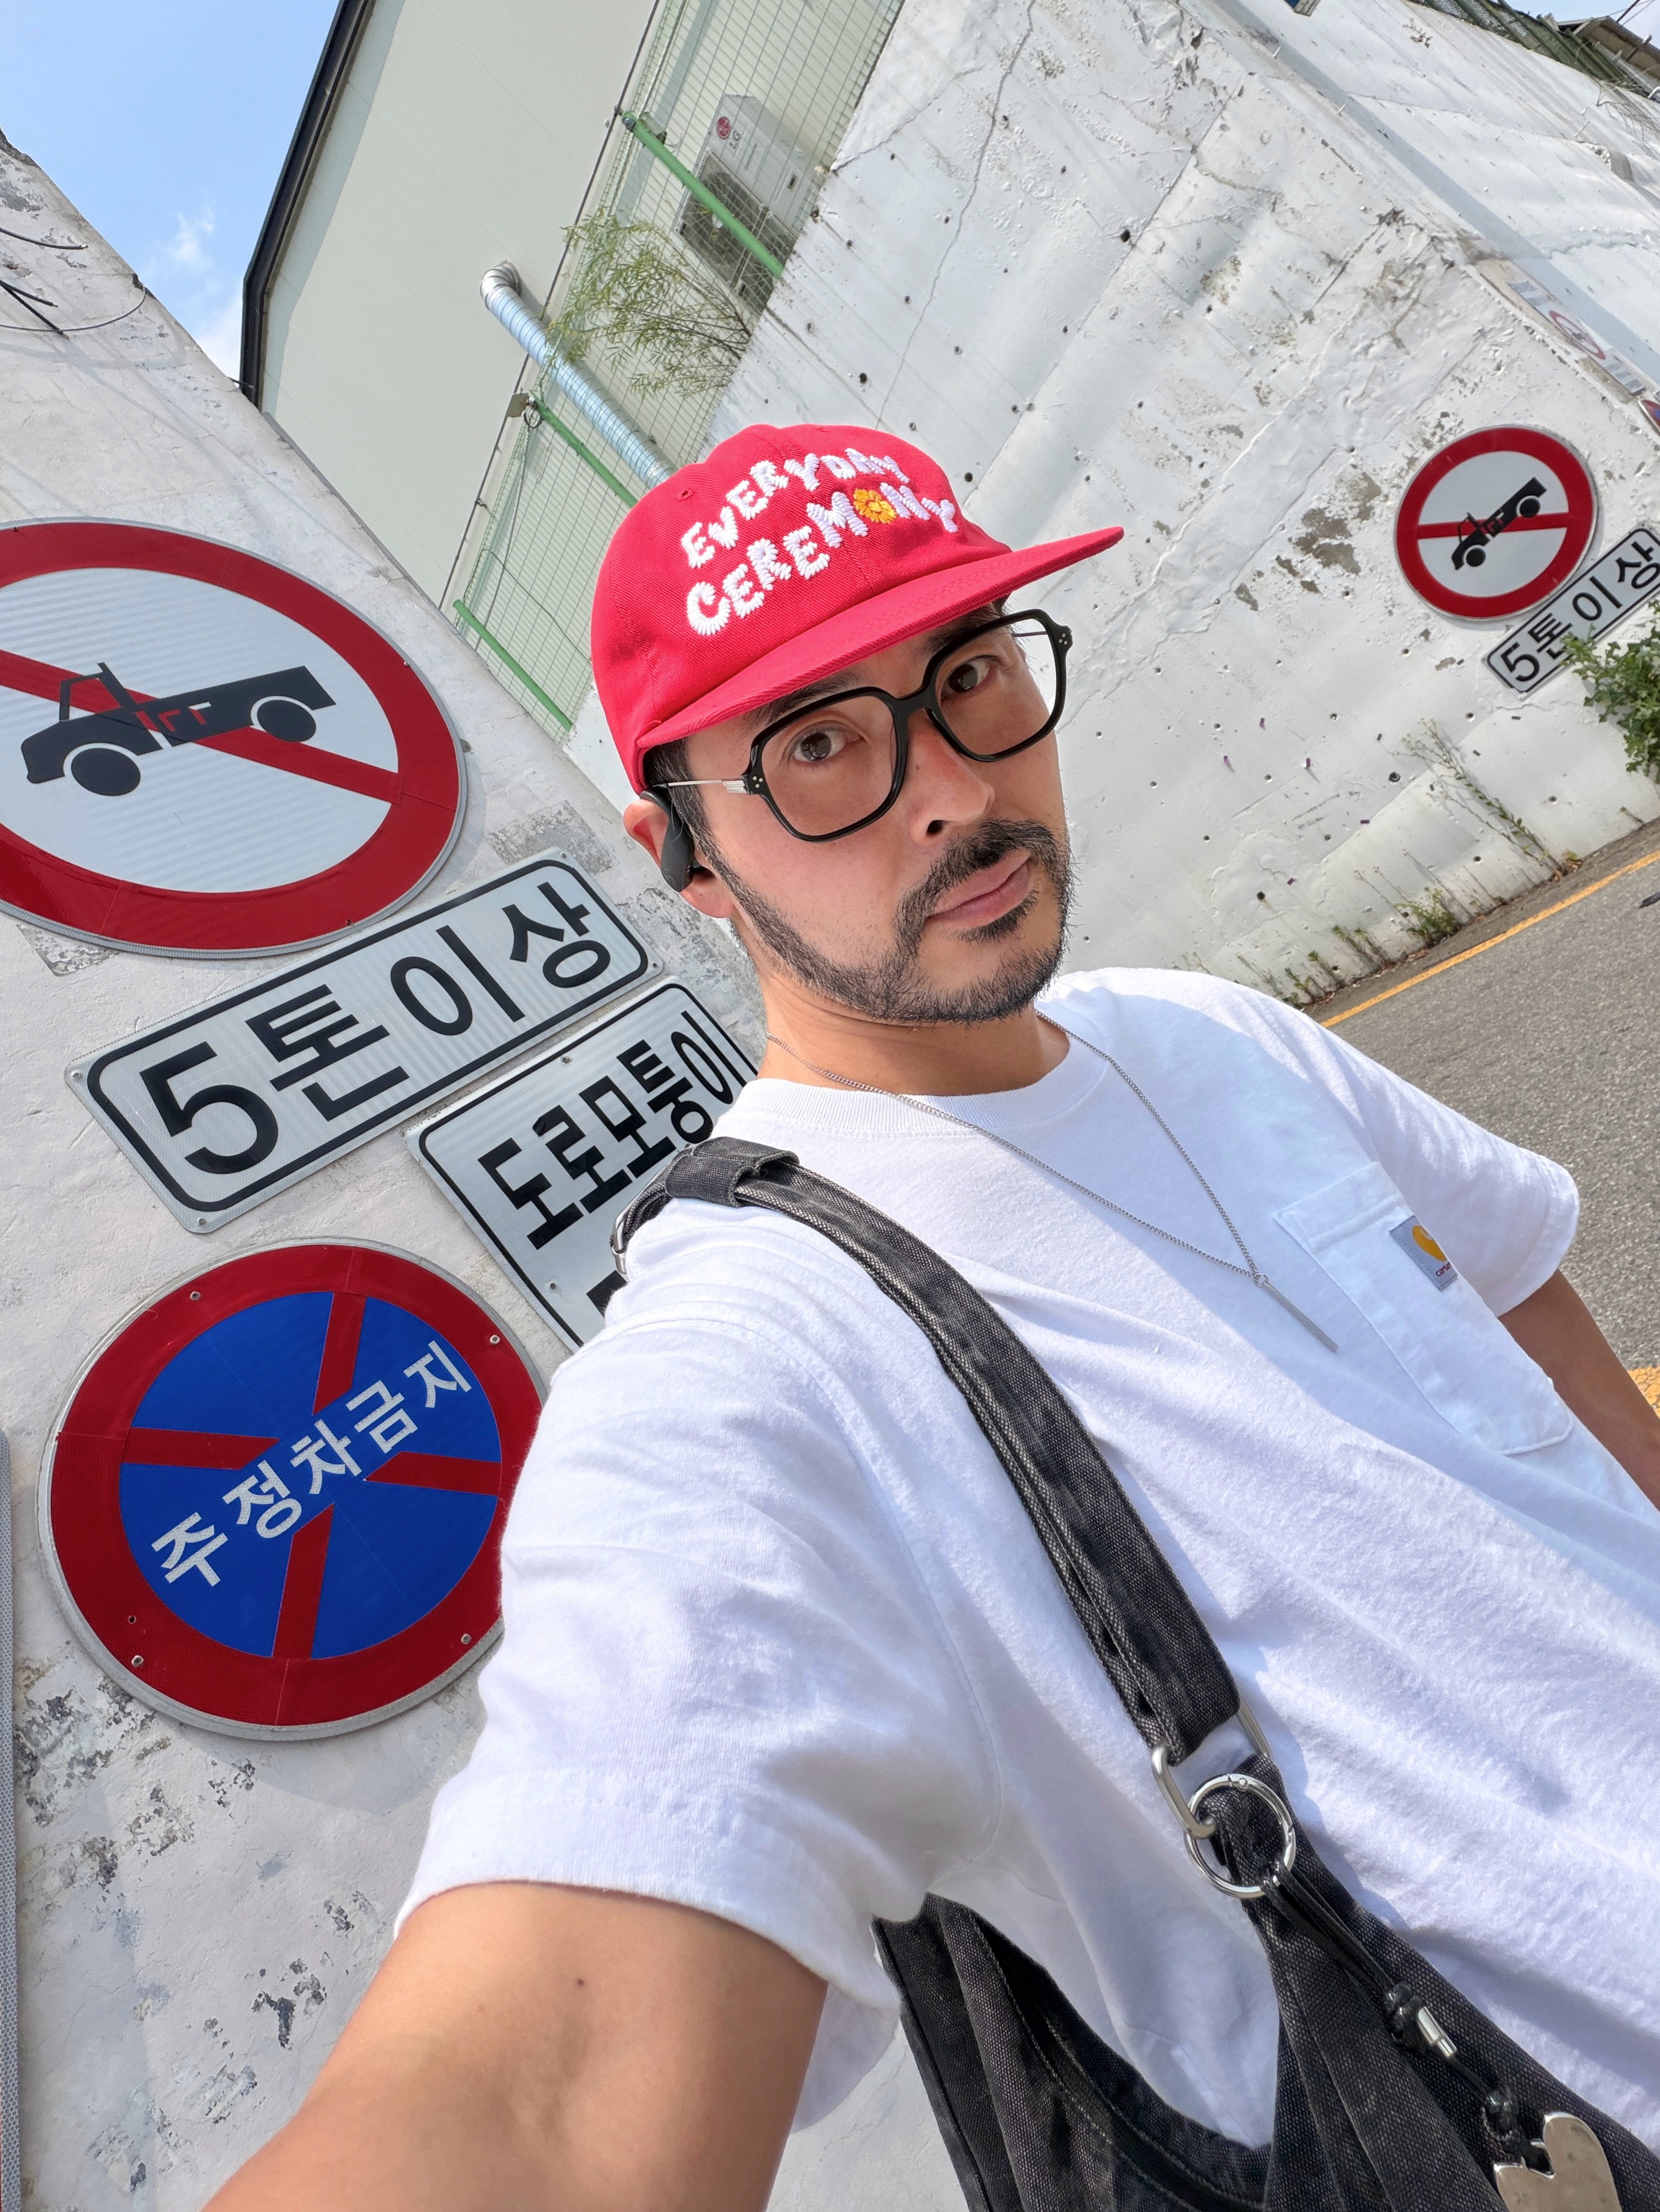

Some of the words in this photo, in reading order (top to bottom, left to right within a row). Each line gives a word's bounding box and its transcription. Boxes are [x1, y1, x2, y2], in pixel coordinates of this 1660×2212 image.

[729, 130, 741, 149] LG
[680, 448, 910, 569] EVERYDAY
[478, 1010, 748, 1250] 도로모퉁이
[151, 1340, 472, 1587] 주정차금지
